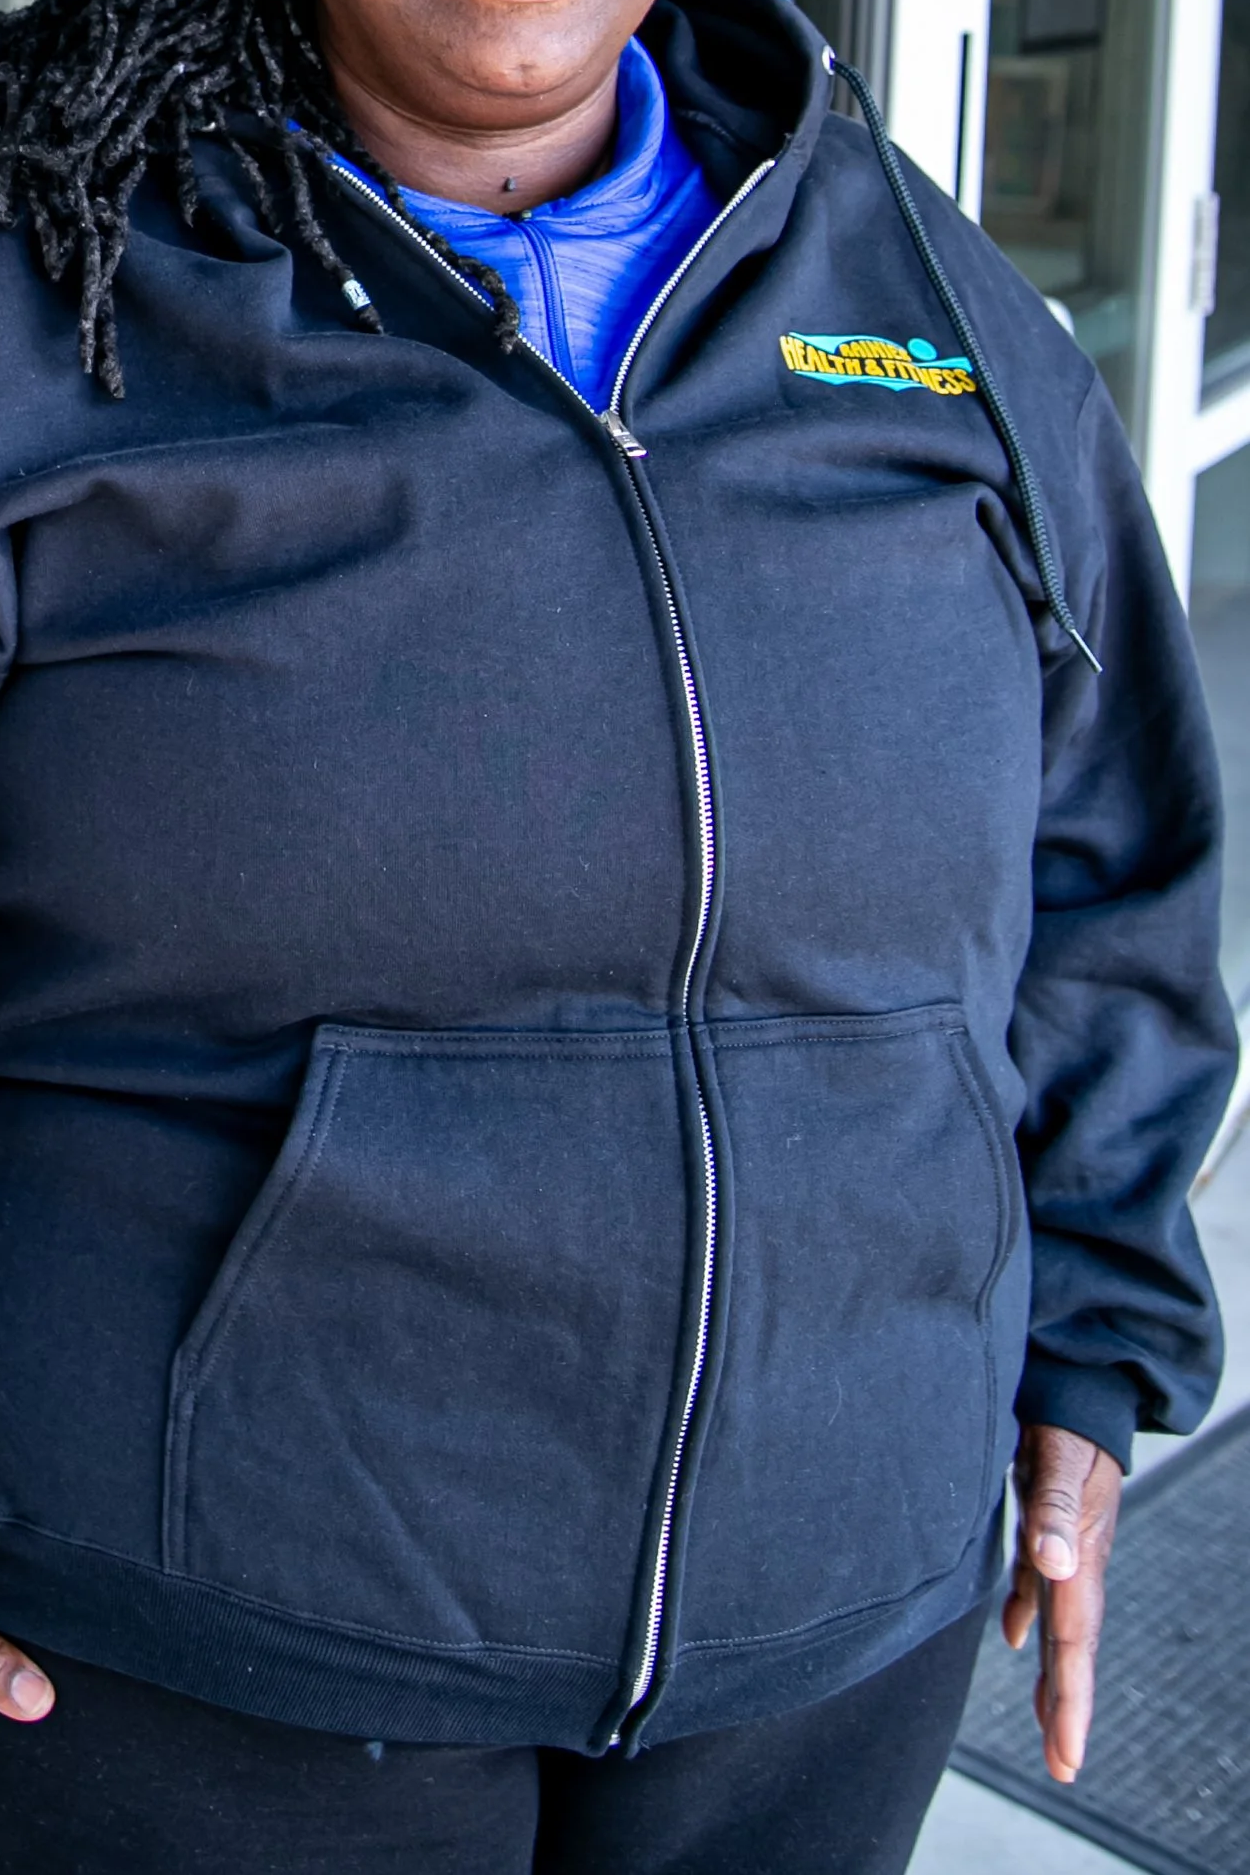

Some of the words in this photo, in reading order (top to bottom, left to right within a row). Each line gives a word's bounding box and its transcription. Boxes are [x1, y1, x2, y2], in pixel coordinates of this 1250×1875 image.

[780, 335, 862, 376] HEALTH
[864, 358, 885, 377] &
[882, 359, 976, 395] FITNESS
[839, 339, 912, 363] RAINIER
